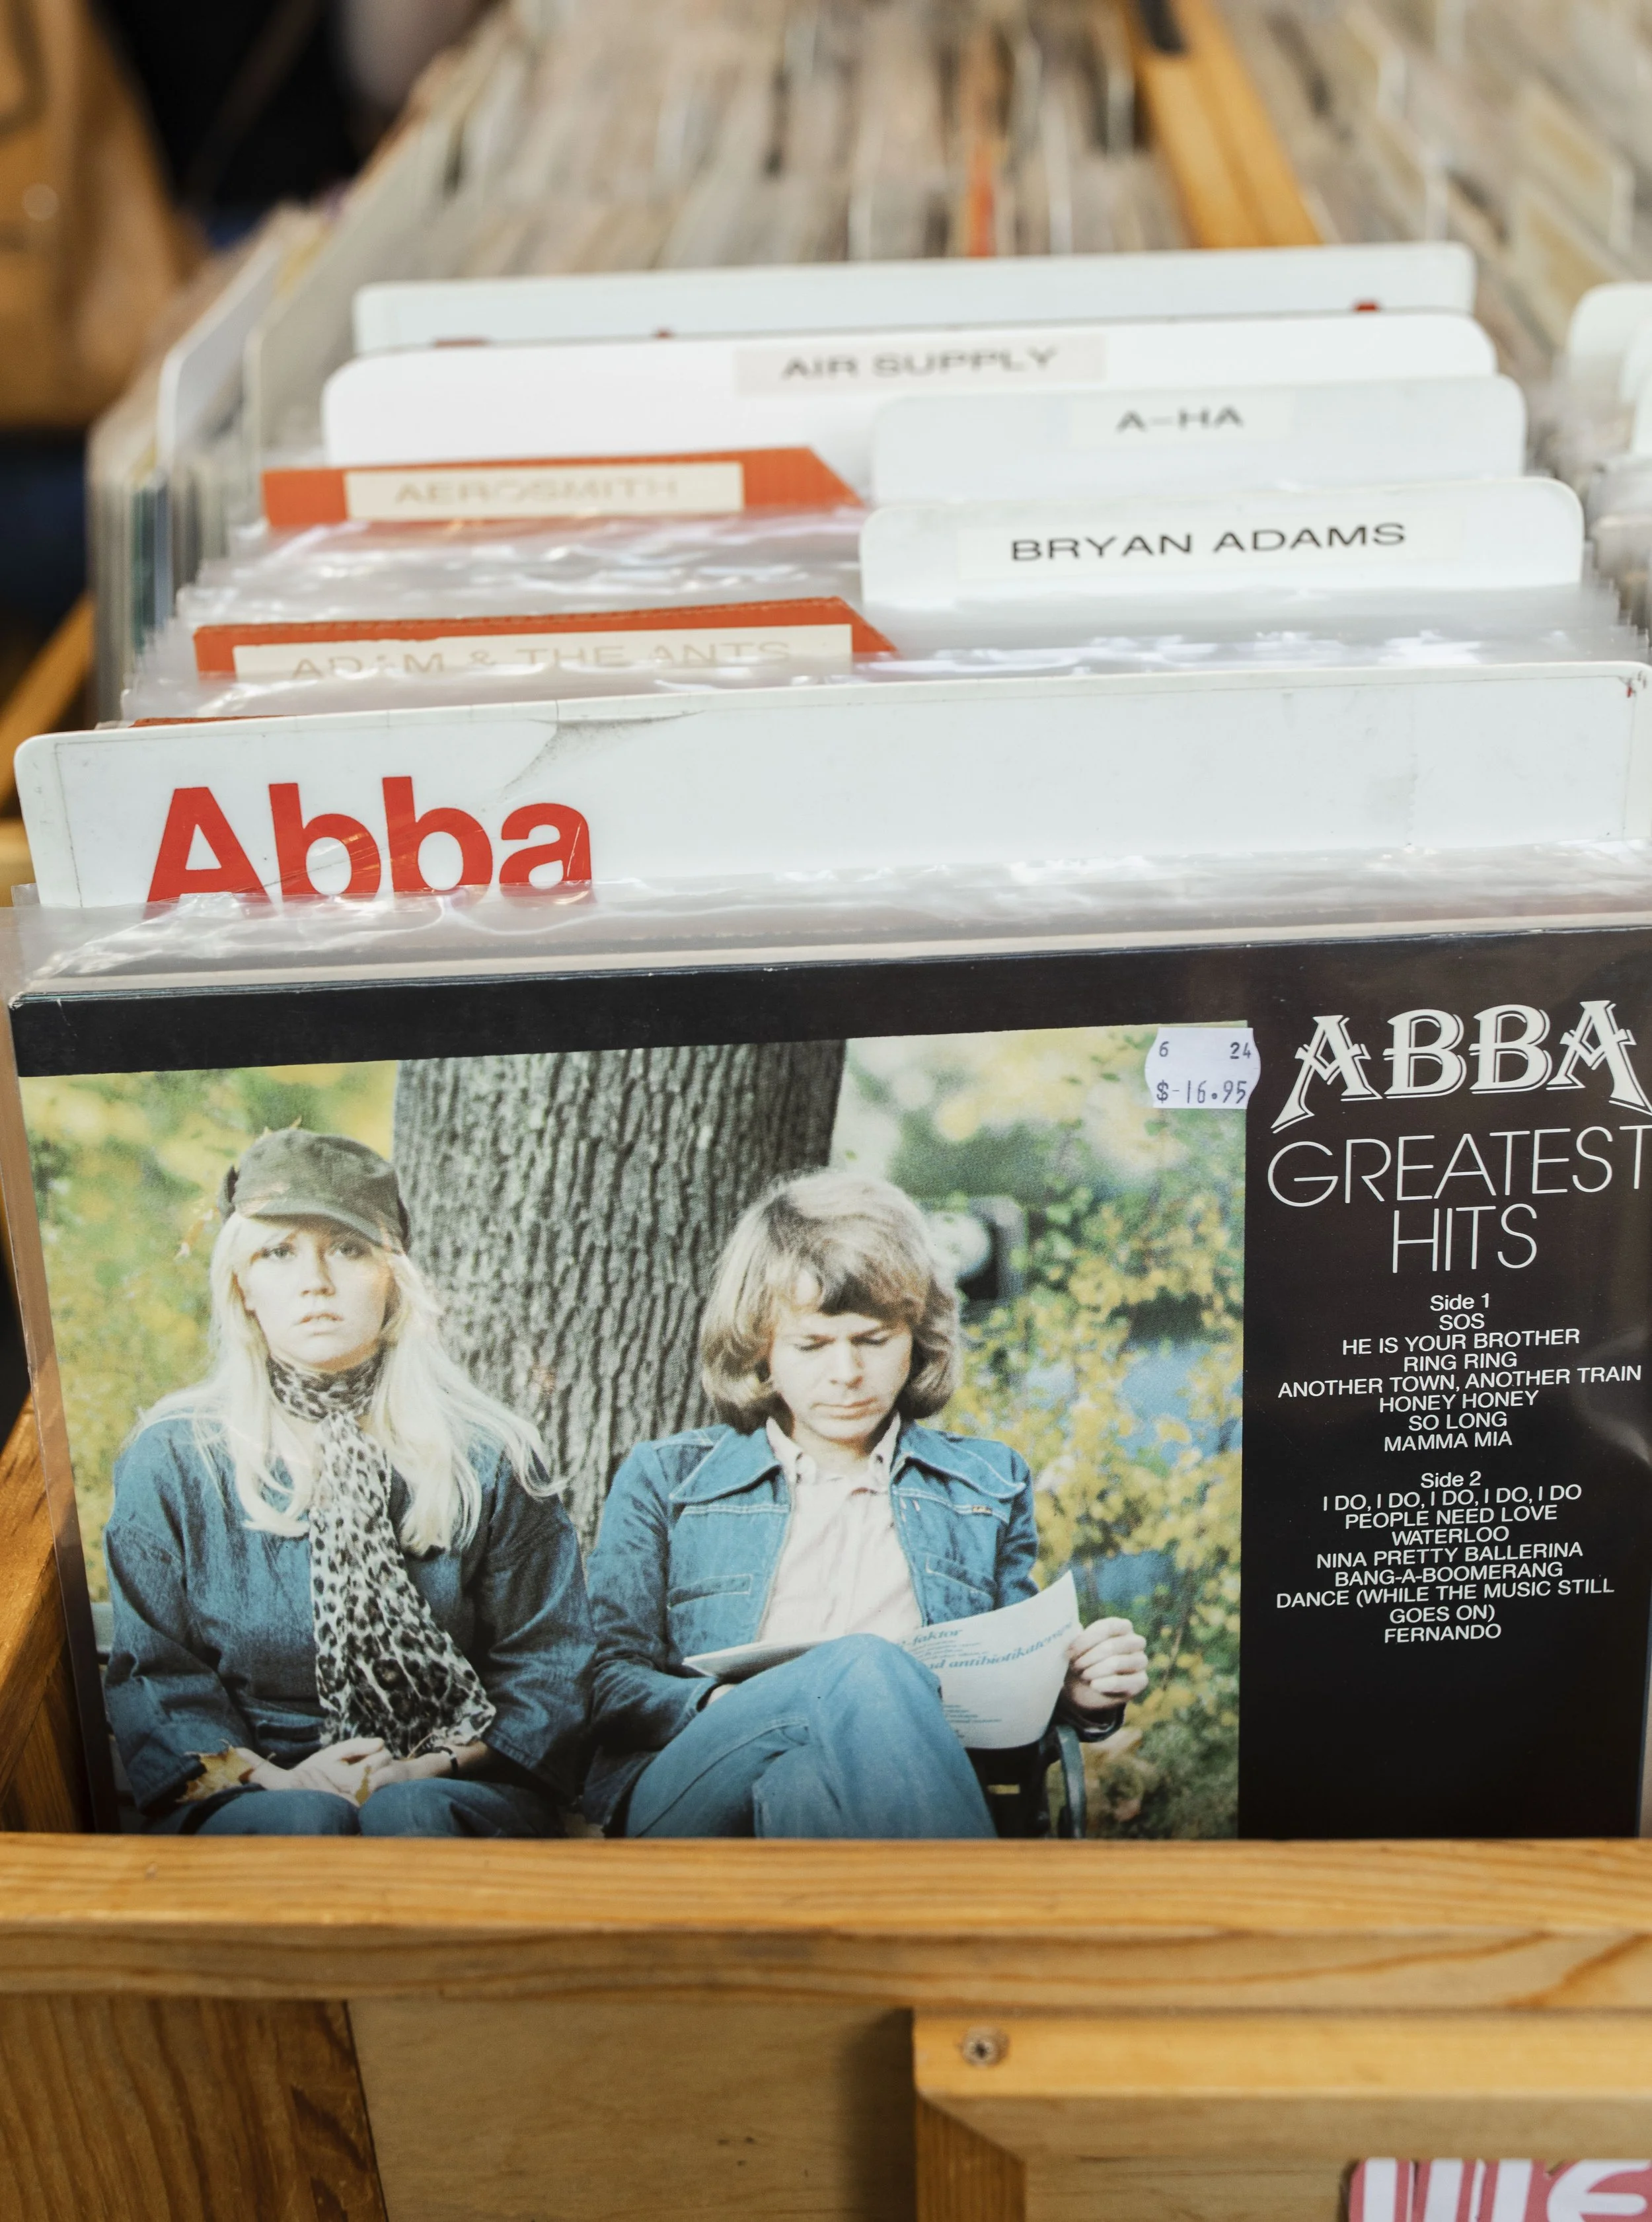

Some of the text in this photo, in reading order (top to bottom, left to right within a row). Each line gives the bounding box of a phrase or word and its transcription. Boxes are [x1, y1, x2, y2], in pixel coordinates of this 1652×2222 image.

[781, 346, 1059, 381] AIR SUPPLY
[1114, 406, 1246, 433] A-HA
[1011, 522, 1407, 562] BRYAN ADAMS
[469, 649, 496, 667] &
[515, 644, 630, 667] THE
[648, 641, 791, 667] ANTS
[141, 775, 598, 920] Abba
[1159, 1041, 1252, 1060] 6 24
[1271, 1000, 1652, 1133] ABBA
[1267, 1125, 1652, 1207] GREATEST
[1392, 1203, 1537, 1273] HITS
[1430, 1293, 1489, 1311] Side 1
[1439, 1313, 1485, 1331] SOS
[1343, 1329, 1579, 1355] HE IS YOUR BROTHER
[1404, 1351, 1517, 1372] RING RING
[1278, 1365, 1641, 1397] ANOTHER TOWN, ANOTHER TRAIN
[1380, 1390, 1538, 1413] HONEY HONEY
[1409, 1411, 1507, 1431] SO LONG
[1384, 1431, 1512, 1452] MAMMA MIA
[1421, 1471, 1481, 1488] Side 2
[1324, 1484, 1581, 1511] I DO, I DO, I DO, I DO, I DO
[1346, 1504, 1557, 1529] PEOPLE NEED LOVE
[1392, 1526, 1509, 1545] WATERLOO
[1318, 1542, 1583, 1569] NINA PRETTY BALLERINA
[1335, 1562, 1562, 1586] BANG-A-BOOMERANG
[1277, 1578, 1614, 1608] DANCE (WHILE THE MUSIC STILL
[1390, 1604, 1495, 1623] GOES ON)
[1385, 1623, 1501, 1643] FERNANDO
